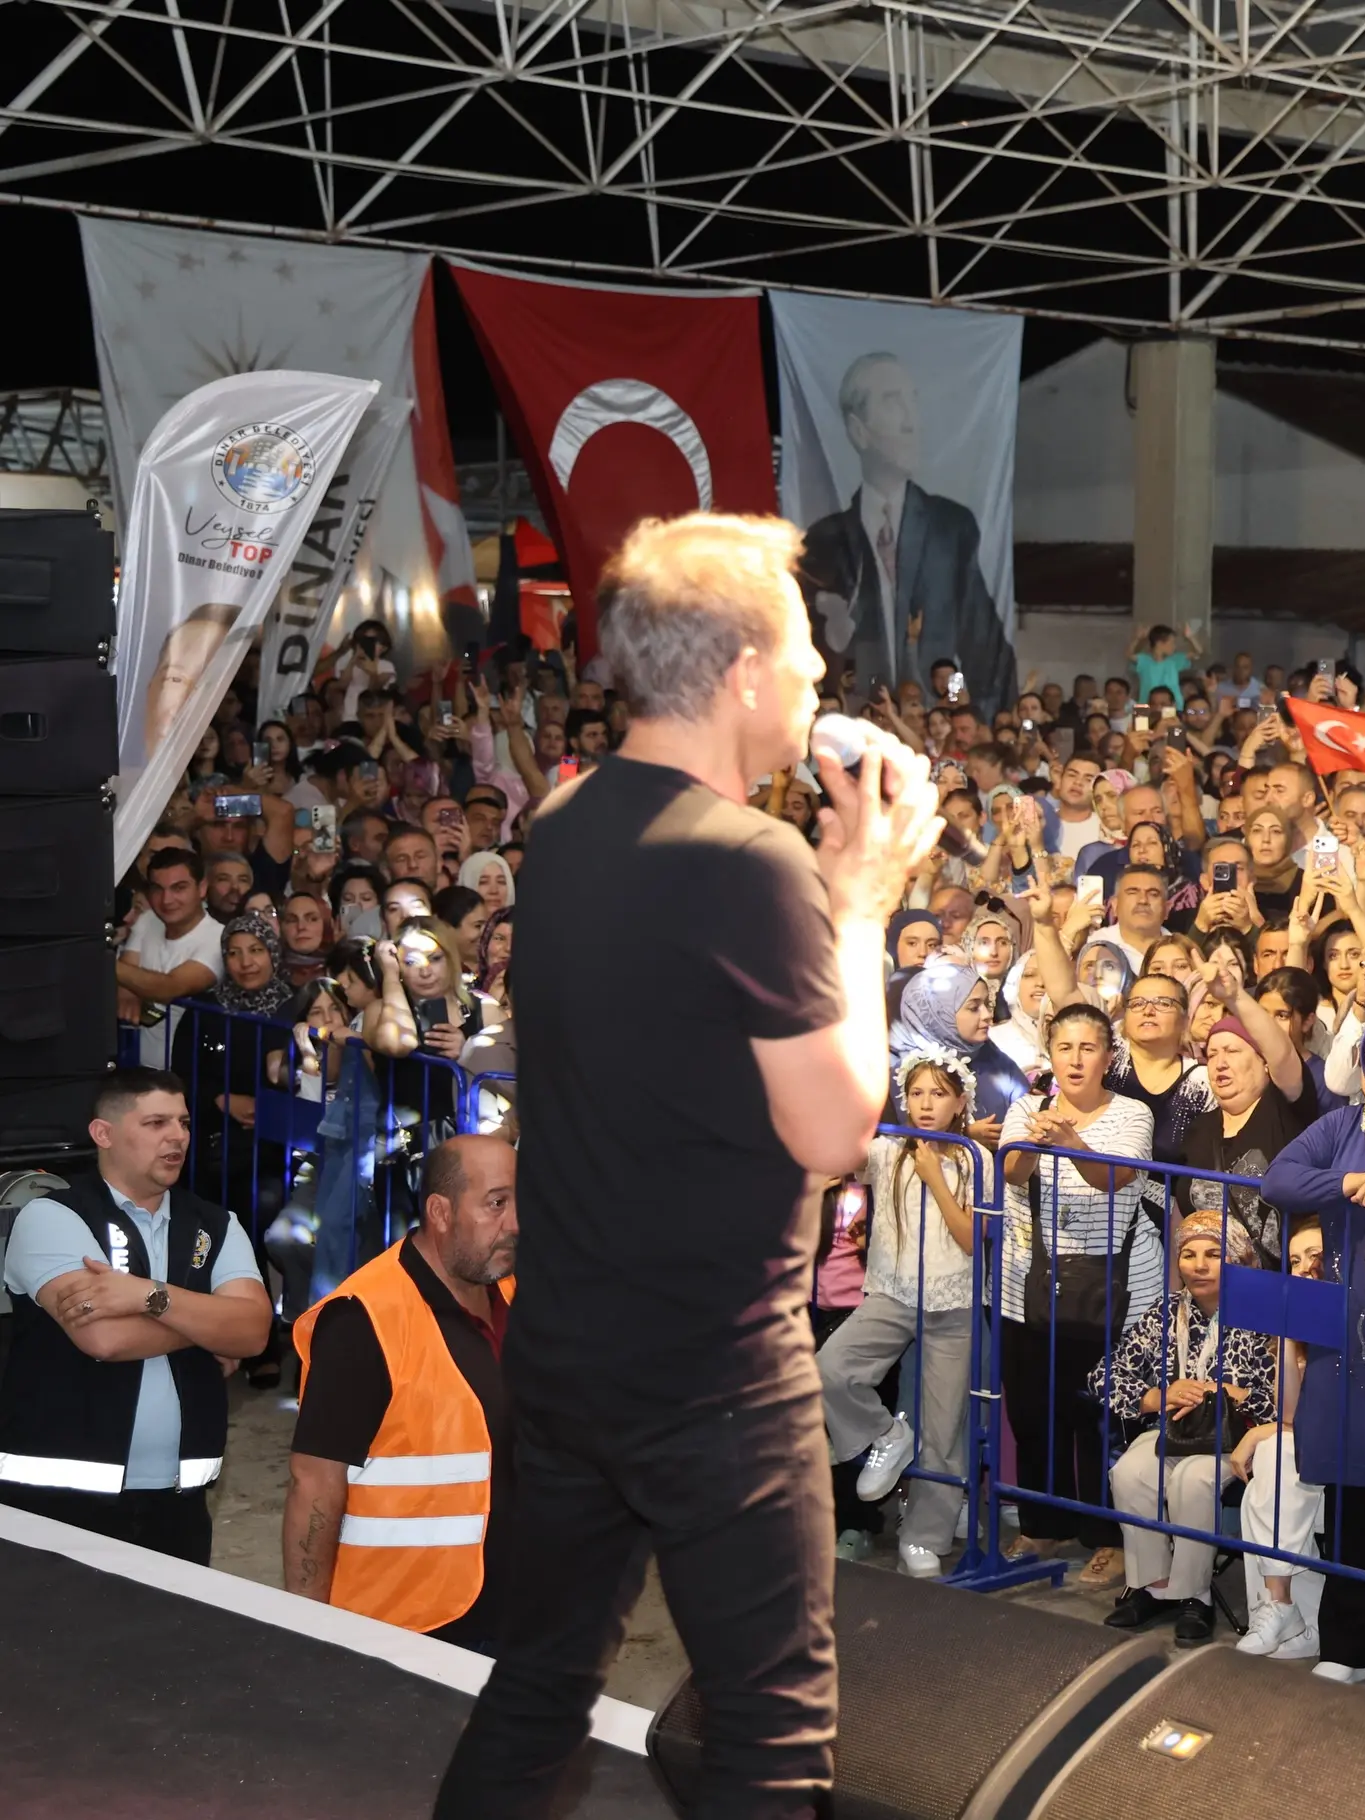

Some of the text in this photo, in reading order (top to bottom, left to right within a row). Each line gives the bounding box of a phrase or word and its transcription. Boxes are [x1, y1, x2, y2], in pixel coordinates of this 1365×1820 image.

[240, 499, 270, 512] 1874
[185, 506, 279, 549] Veysel
[178, 552, 207, 567] Dinar
[230, 541, 273, 564] TOP
